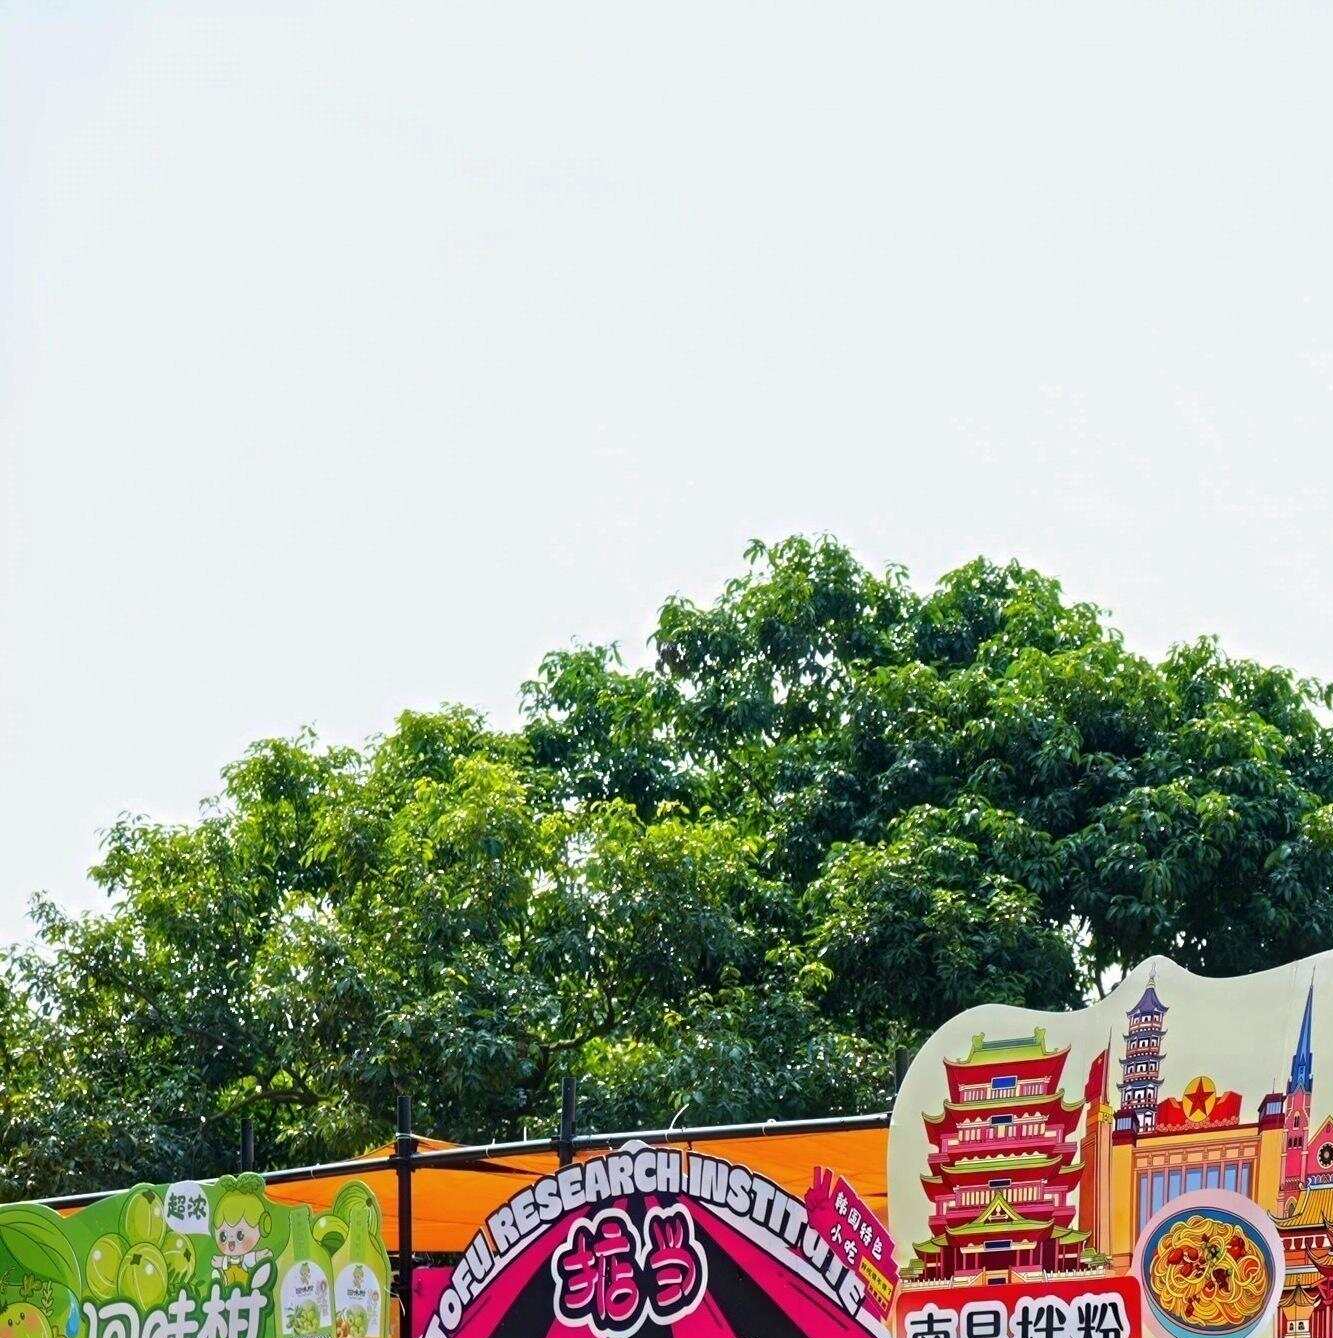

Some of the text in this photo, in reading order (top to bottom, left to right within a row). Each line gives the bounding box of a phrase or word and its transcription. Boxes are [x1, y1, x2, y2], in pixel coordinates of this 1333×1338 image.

[166, 1194, 208, 1221] 超浓
[486, 1147, 684, 1247] RESEARCH
[687, 1153, 870, 1314] INSTITUTE
[835, 1191, 882, 1260] 韩国特色
[820, 1223, 857, 1264] 小吃
